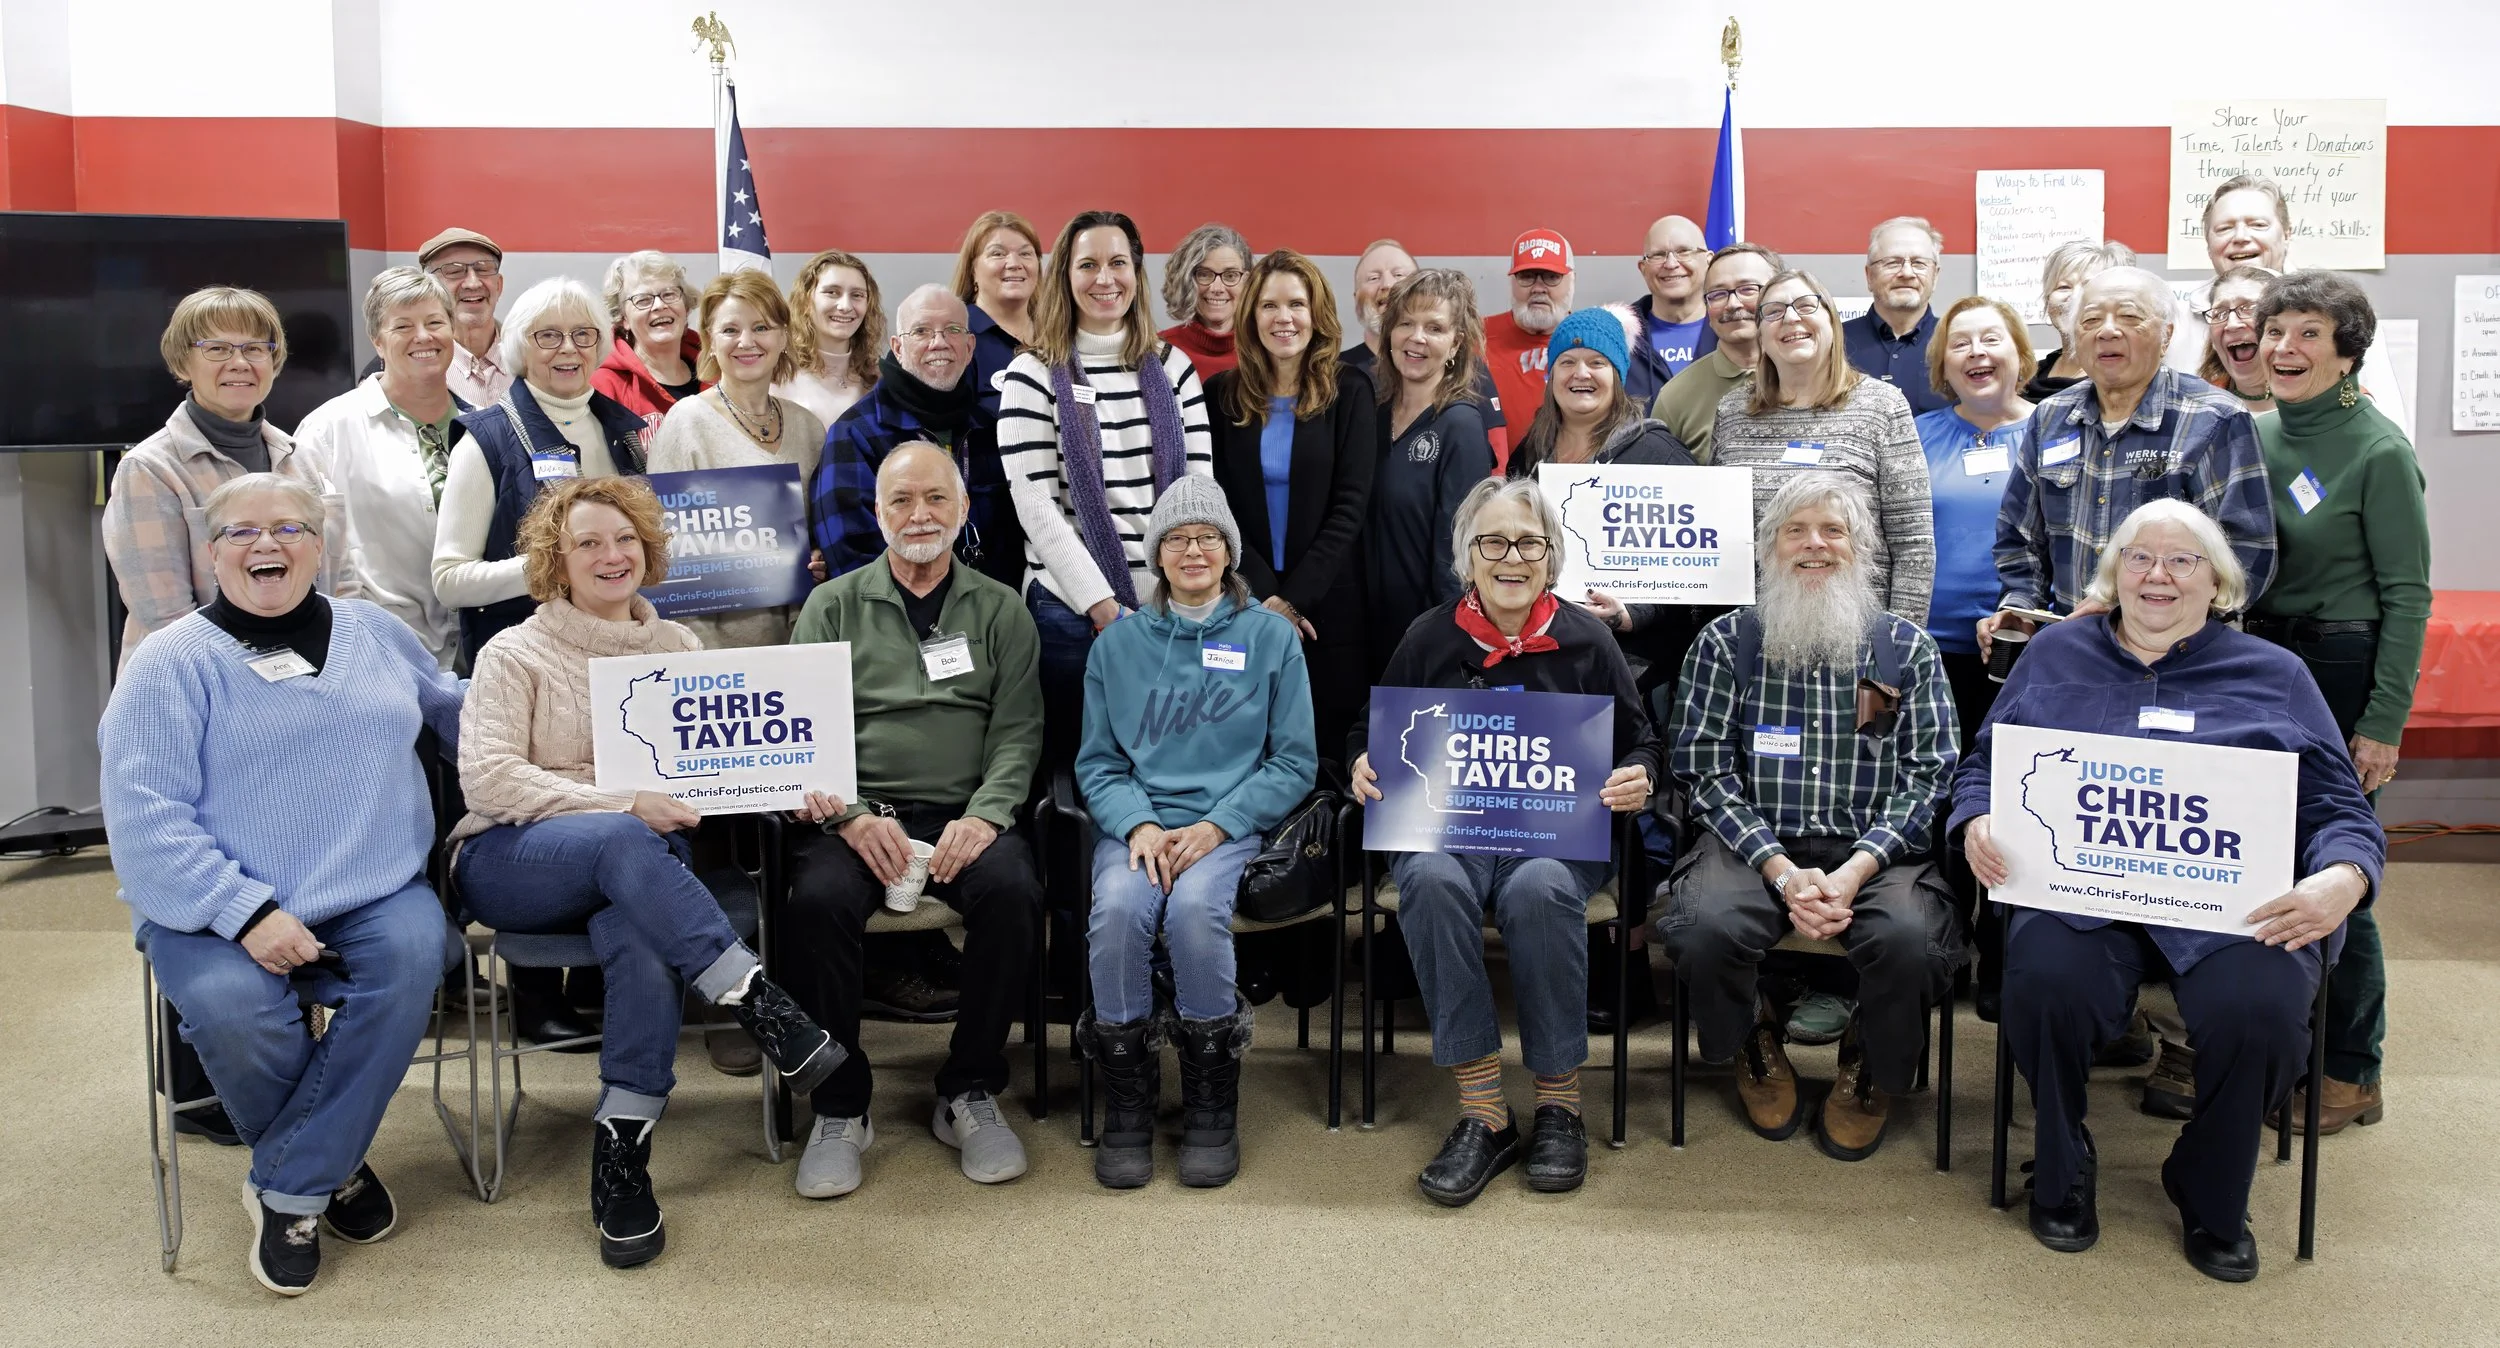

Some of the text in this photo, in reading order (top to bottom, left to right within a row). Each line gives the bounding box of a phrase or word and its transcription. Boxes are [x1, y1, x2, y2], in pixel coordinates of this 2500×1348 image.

[2212, 106, 2309, 134] Share Your
[2180, 133, 2224, 153] Time,
[2231, 133, 2284, 152] Talents
[2306, 132, 2374, 152] Donations
[2197, 159, 2345, 184] through a variety of
[1995, 174, 2026, 195] Ways
[2028, 174, 2039, 187] to
[2043, 173, 2065, 188] Find
[2303, 184, 2323, 204] fit
[2331, 191, 2359, 207] your
[2330, 218, 2371, 236] Skills:
[1518, 238, 1561, 256] BADGERS
[1531, 247, 1546, 260] W
[2125, 449, 2158, 459] WERK
[1602, 485, 1663, 501] JUDGE
[1602, 502, 1695, 525] CHRIS
[1602, 526, 1718, 549] TAYLOR
[733, 556, 780, 570] COURT
[1603, 555, 1720, 567] SUPREME COURT
[1584, 580, 1708, 590] www.ChrisForJustice.com
[273, 663, 291, 671] Ann
[941, 656, 957, 666] Bob
[1207, 653, 1234, 665] Janice
[671, 672, 745, 697] JUDGE
[672, 690, 784, 722] CHRIS
[1131, 671, 1260, 750] Nike
[673, 717, 813, 750] TAYLOR
[1448, 713, 1516, 732] JUDGE
[1446, 733, 1551, 762] CHRIS
[676, 751, 815, 772] SUPREME COURT
[1445, 760, 1576, 792] TAYLOR
[2078, 760, 2164, 786] JUDGE
[1445, 794, 1576, 813] SUPREME COURT
[2077, 784, 2209, 824] CHRIS
[1415, 825, 1556, 841] www.ChrisForJustice.com
[2076, 814, 2242, 860] TAYLOR
[2076, 852, 2242, 885] SUPREME COURT
[2049, 883, 2223, 912] www.ChrisForJustice.com
